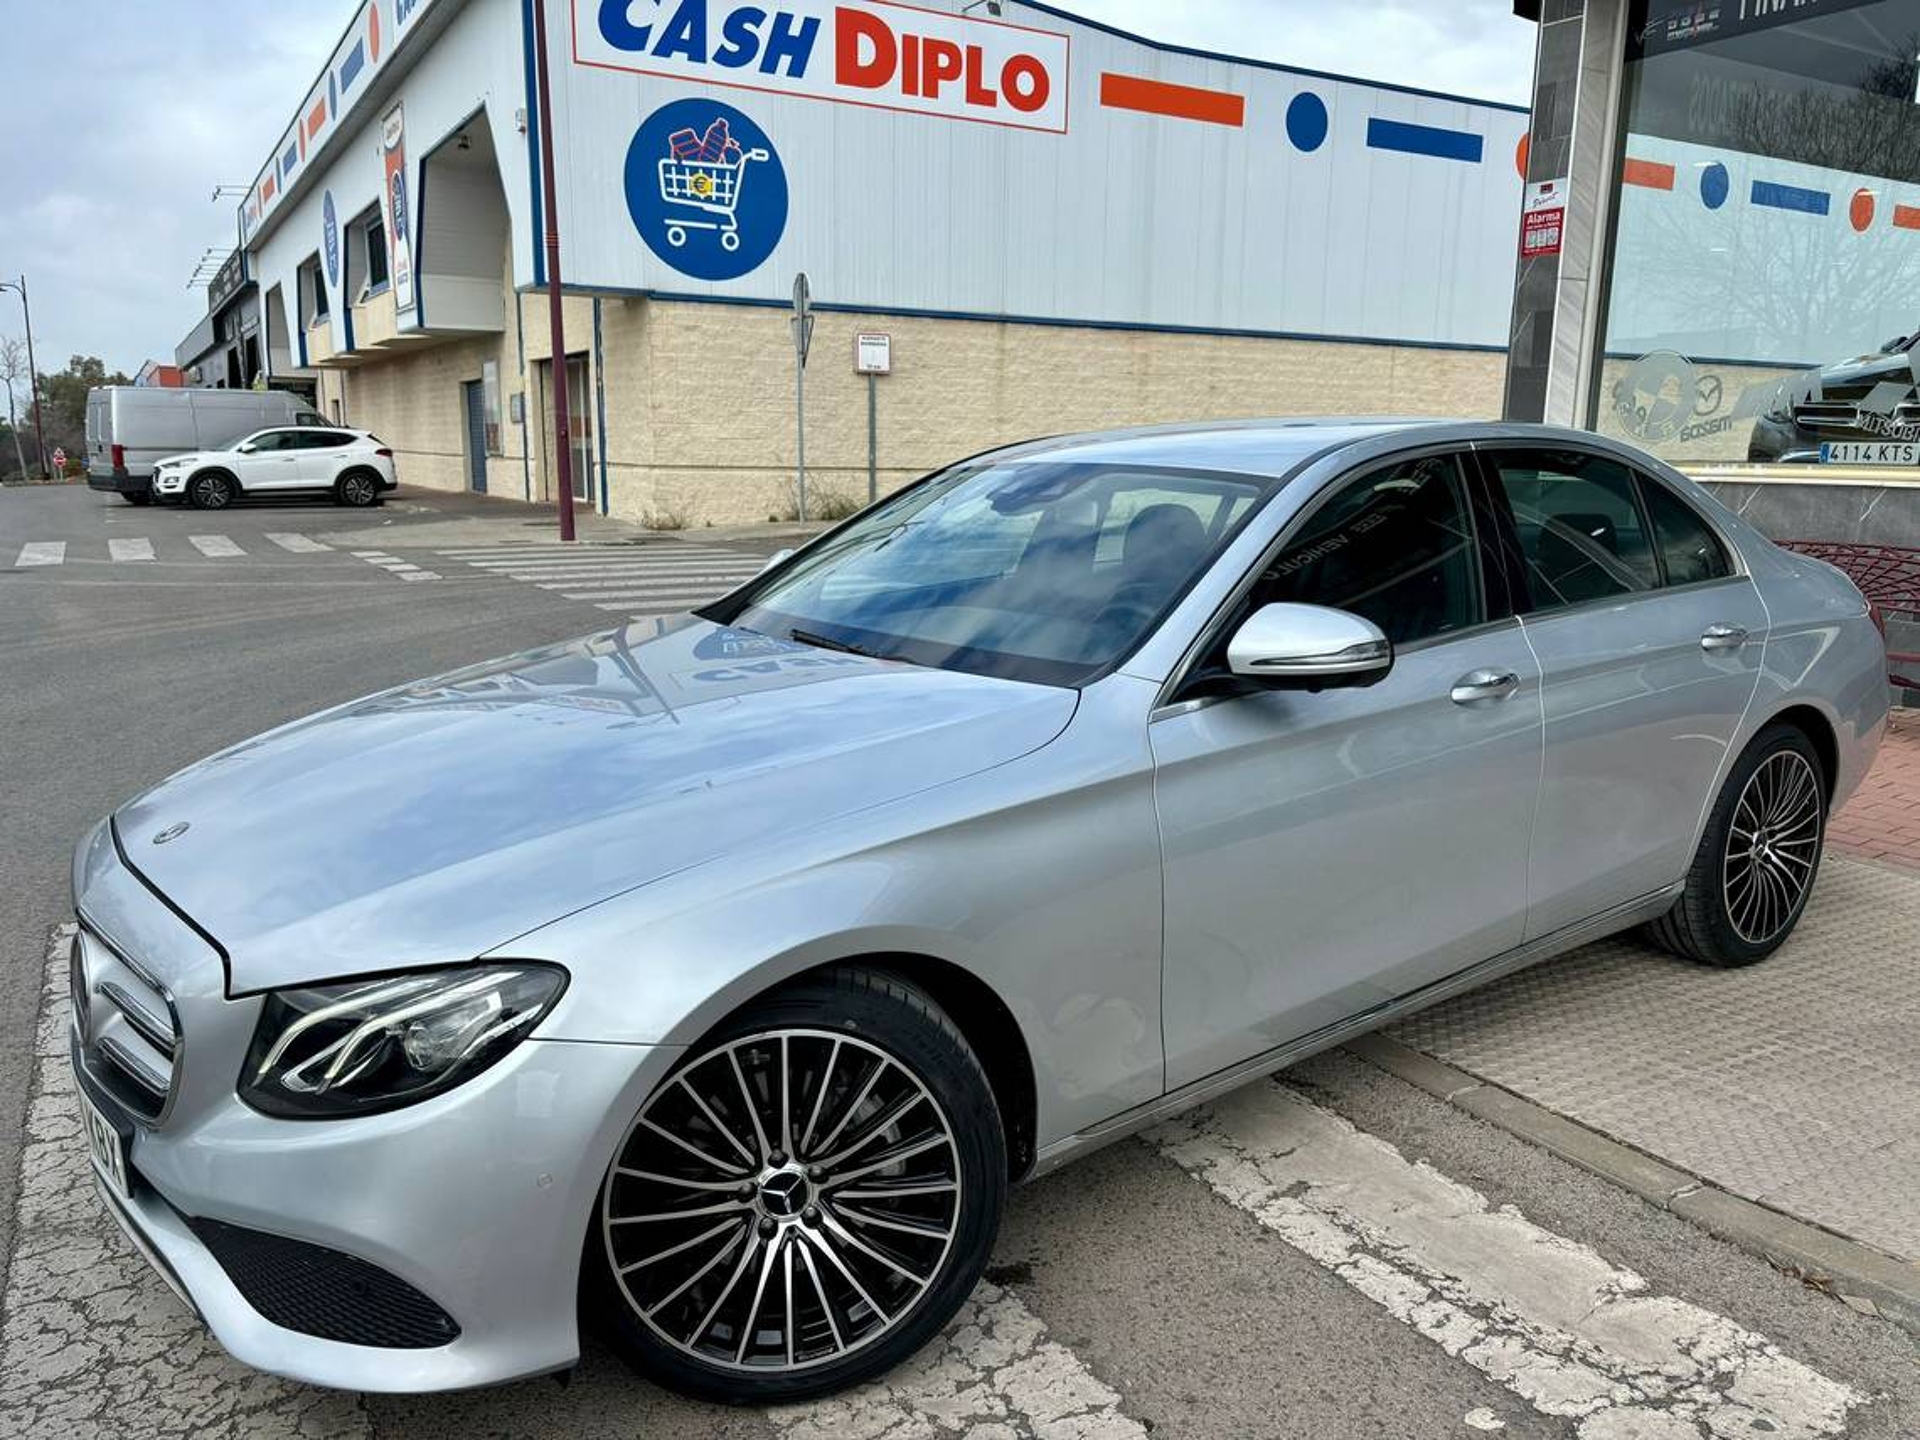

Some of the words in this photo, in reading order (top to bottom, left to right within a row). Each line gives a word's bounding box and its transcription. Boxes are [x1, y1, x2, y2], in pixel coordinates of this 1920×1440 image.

[598, 0, 822, 79] CASH
[834, 6, 1050, 113] DIPLO
[1527, 211, 1561, 225] Alarma
[1830, 444, 1872, 462] 4114
[1878, 445, 1914, 462] KTS
